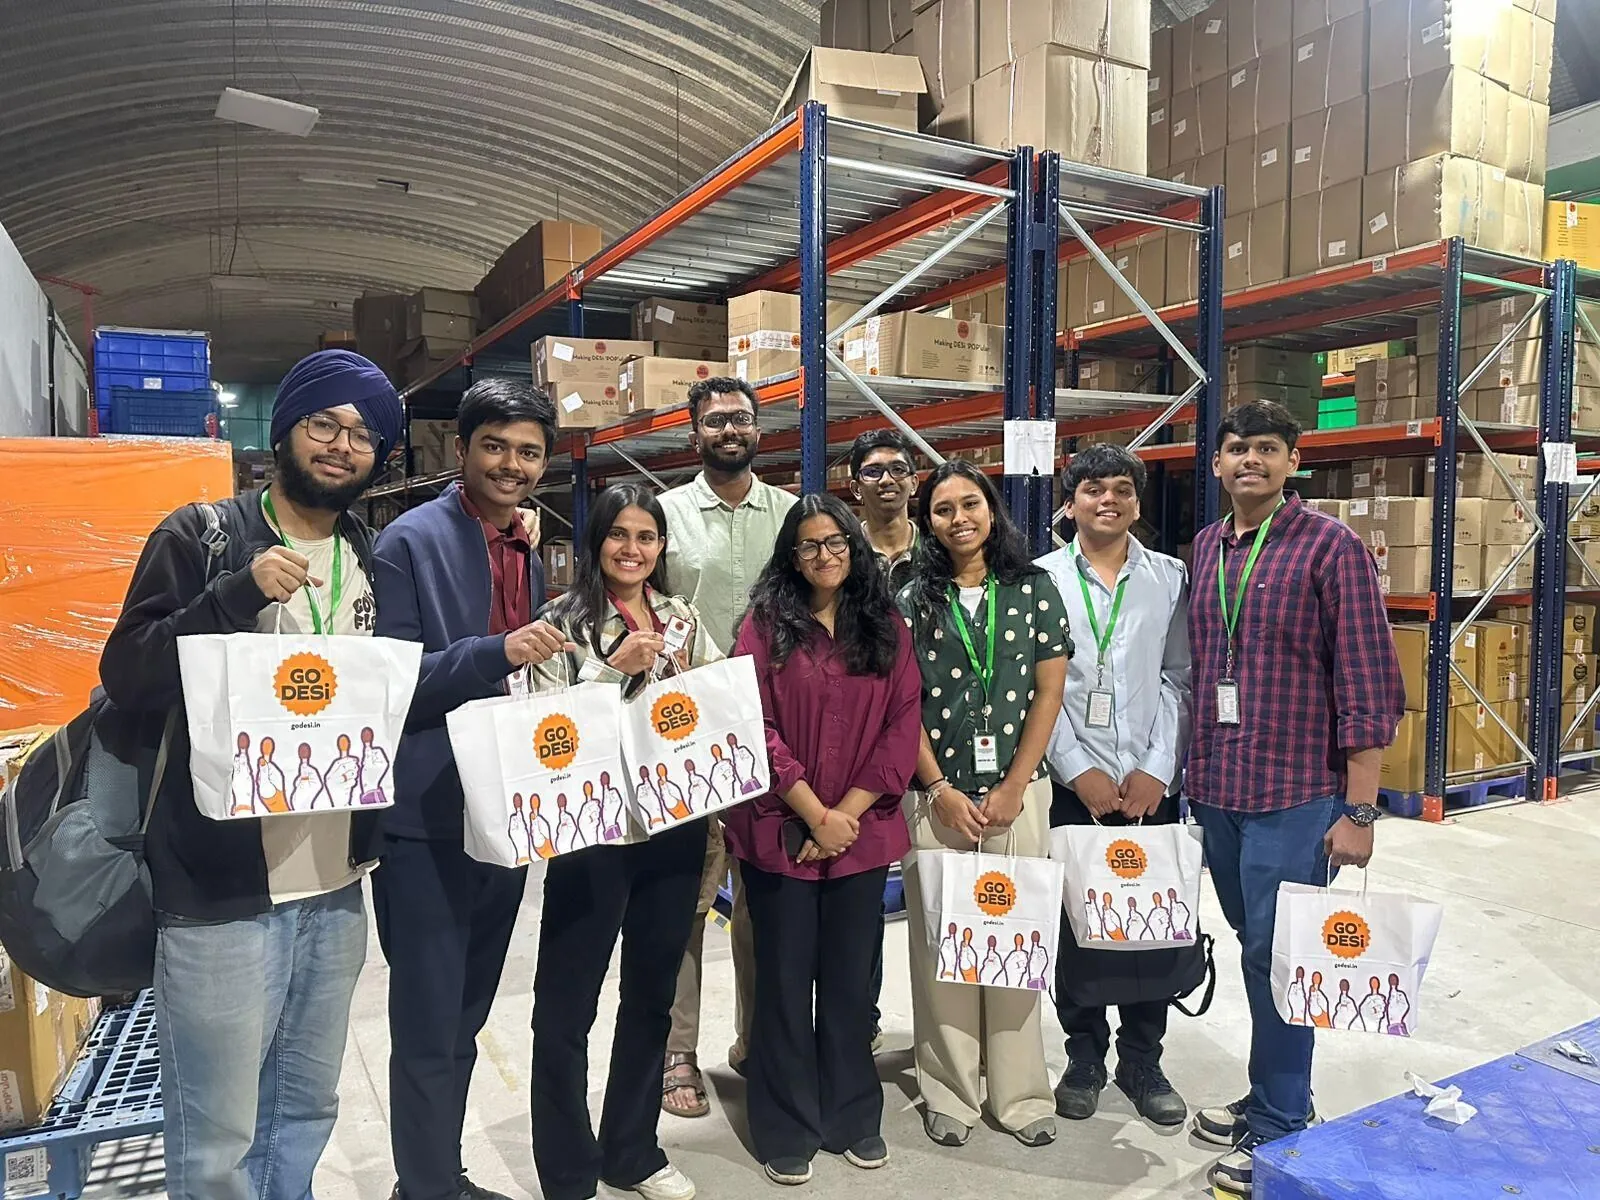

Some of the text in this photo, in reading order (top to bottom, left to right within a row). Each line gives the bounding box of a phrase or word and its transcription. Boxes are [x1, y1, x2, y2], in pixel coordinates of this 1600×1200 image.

[290, 668, 321, 684] GO
[660, 702, 684, 719] GO
[291, 722, 321, 731] godesi.in
[544, 726, 568, 743] GO
[1115, 848, 1136, 858] GO
[984, 881, 1005, 893] GO
[1333, 922, 1357, 934] GO
